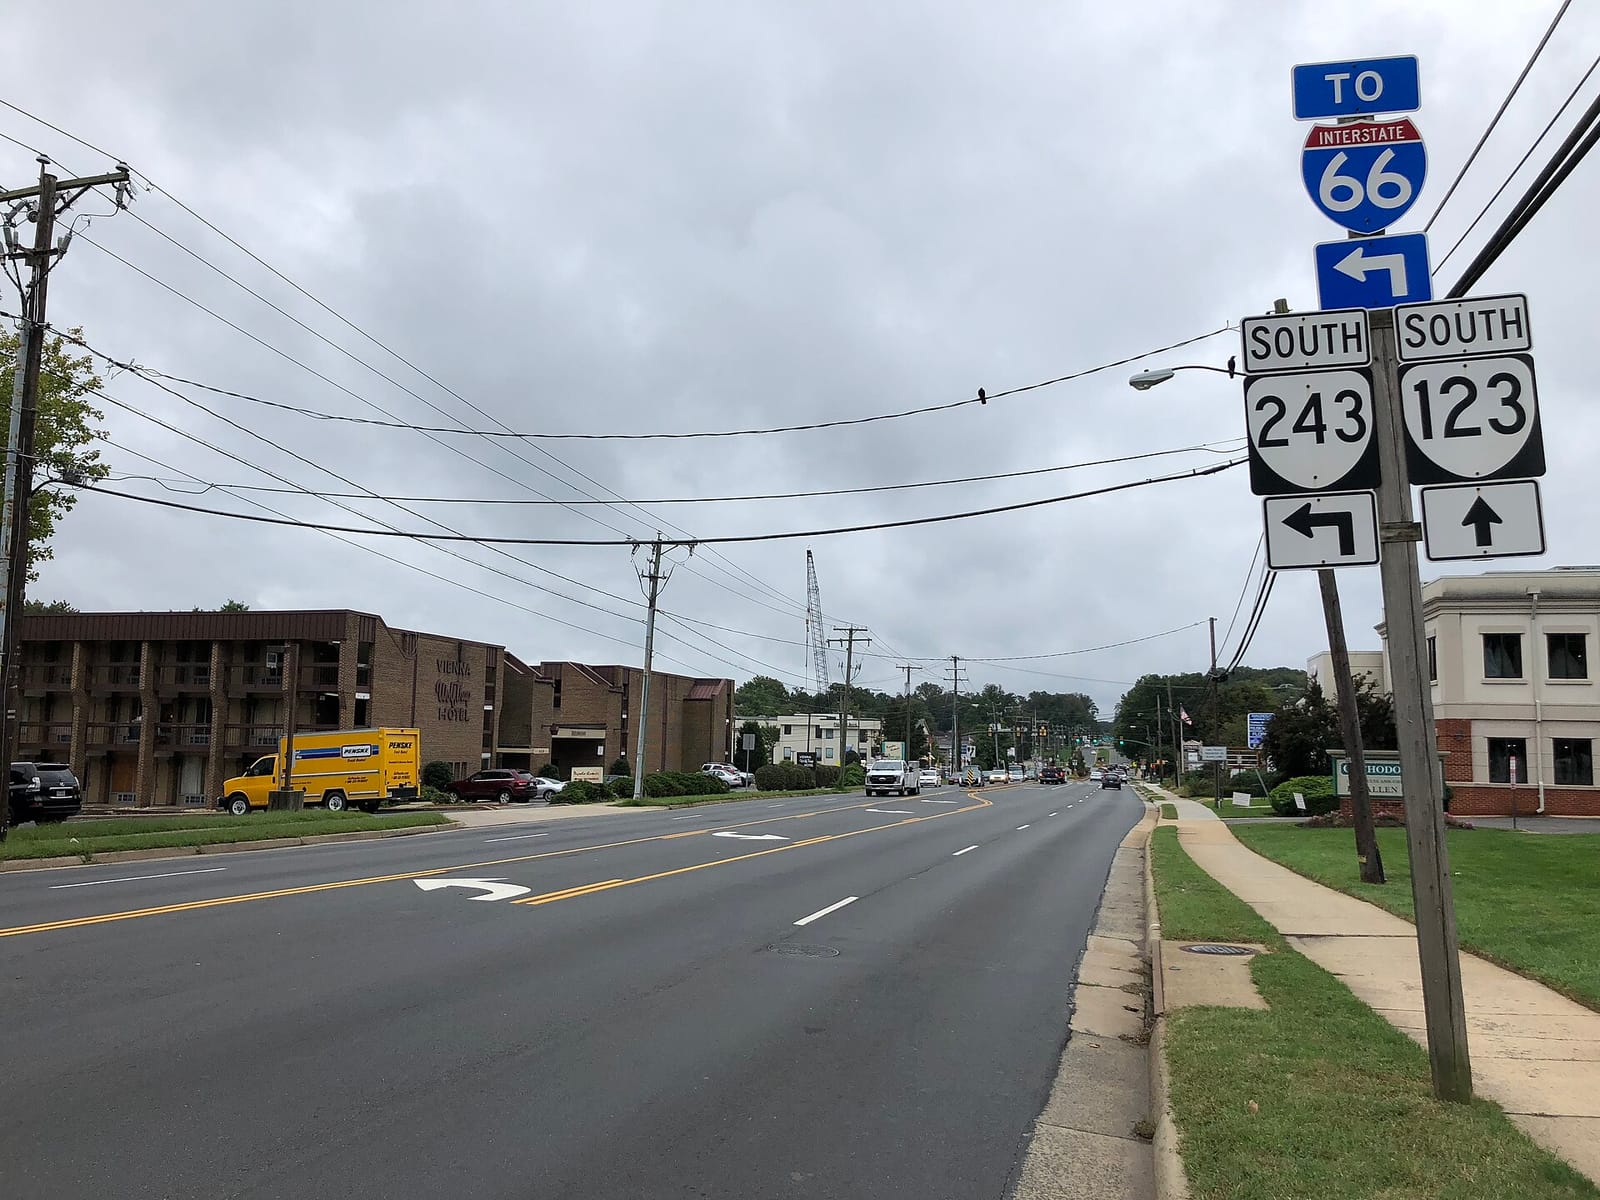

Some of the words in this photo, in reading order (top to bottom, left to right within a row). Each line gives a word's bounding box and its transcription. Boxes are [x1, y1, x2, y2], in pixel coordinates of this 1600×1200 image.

[1324, 70, 1384, 104] TO
[1319, 126, 1405, 145] INTERSTATE
[1319, 148, 1412, 212] 66
[1251, 321, 1363, 360] SOUTH
[1405, 307, 1523, 348] SOUTH
[1255, 389, 1367, 449] 243
[1413, 372, 1527, 440] 123
[436, 659, 471, 676] VIENNA
[438, 707, 470, 722] HOTEL
[343, 747, 369, 755] PENSKE
[388, 741, 413, 749] PENSKE
